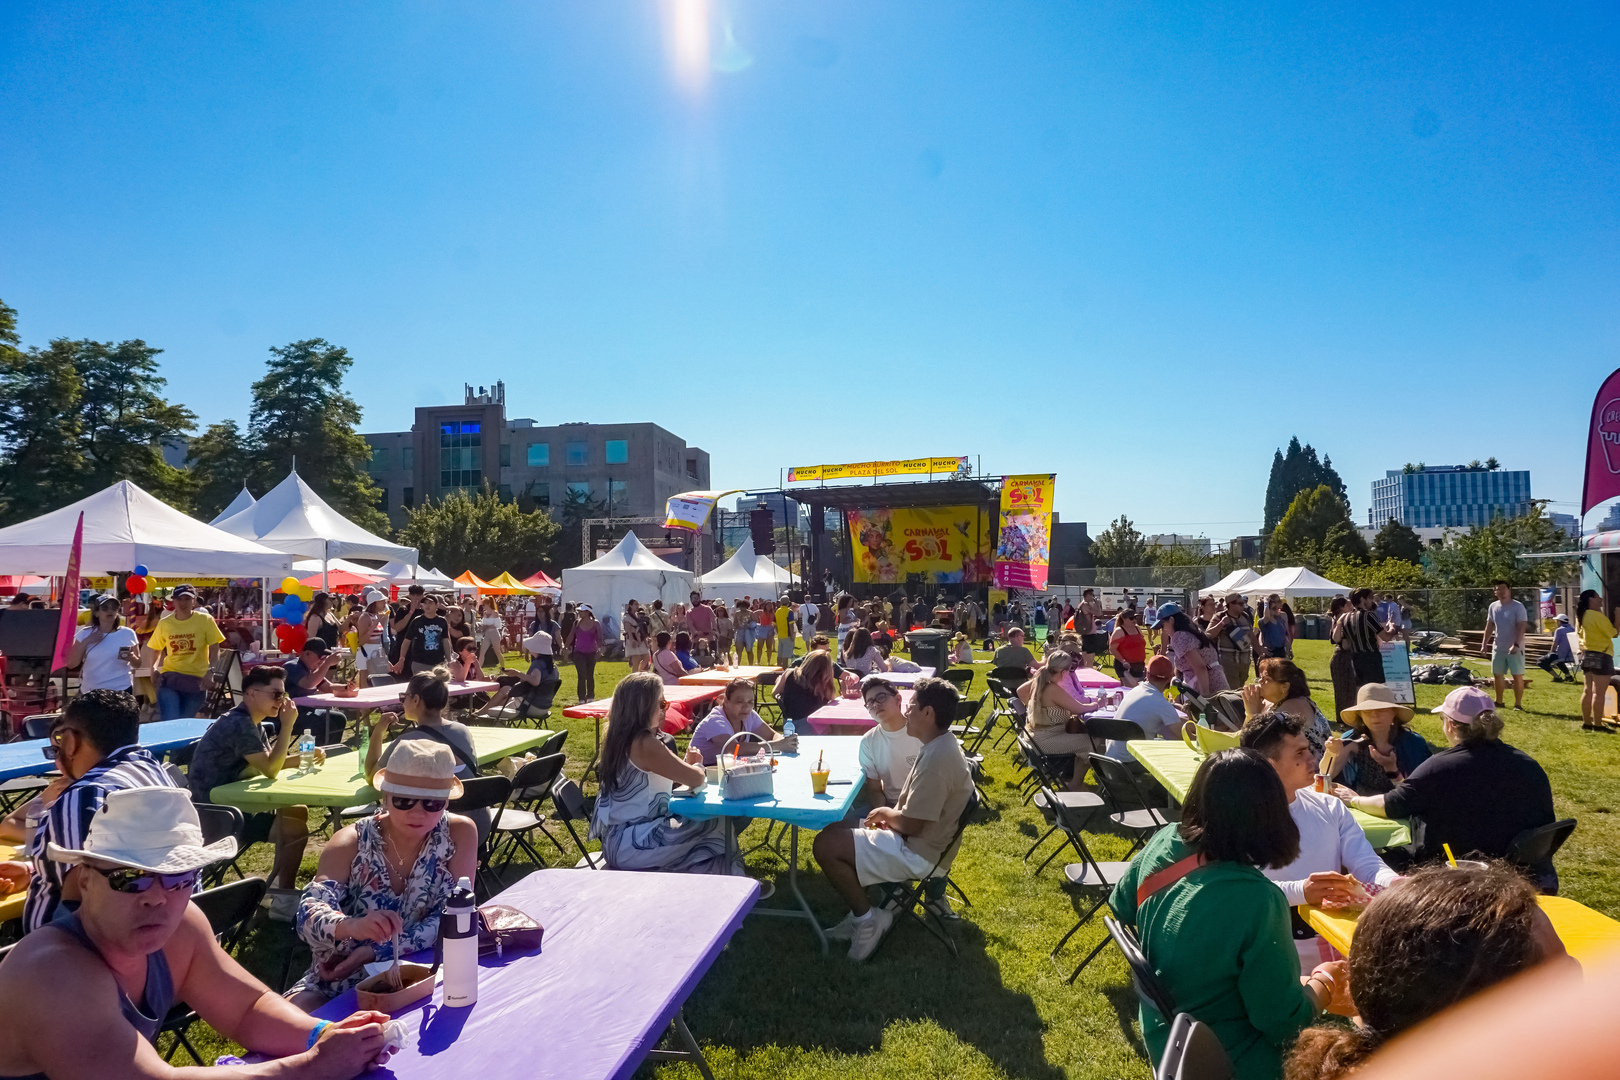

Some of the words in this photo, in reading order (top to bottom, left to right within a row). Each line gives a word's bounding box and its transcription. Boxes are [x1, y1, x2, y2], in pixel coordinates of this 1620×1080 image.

[904, 528, 950, 537] CARNAVAL
[906, 539, 952, 561] SOL
[170, 640, 196, 653] SOL
